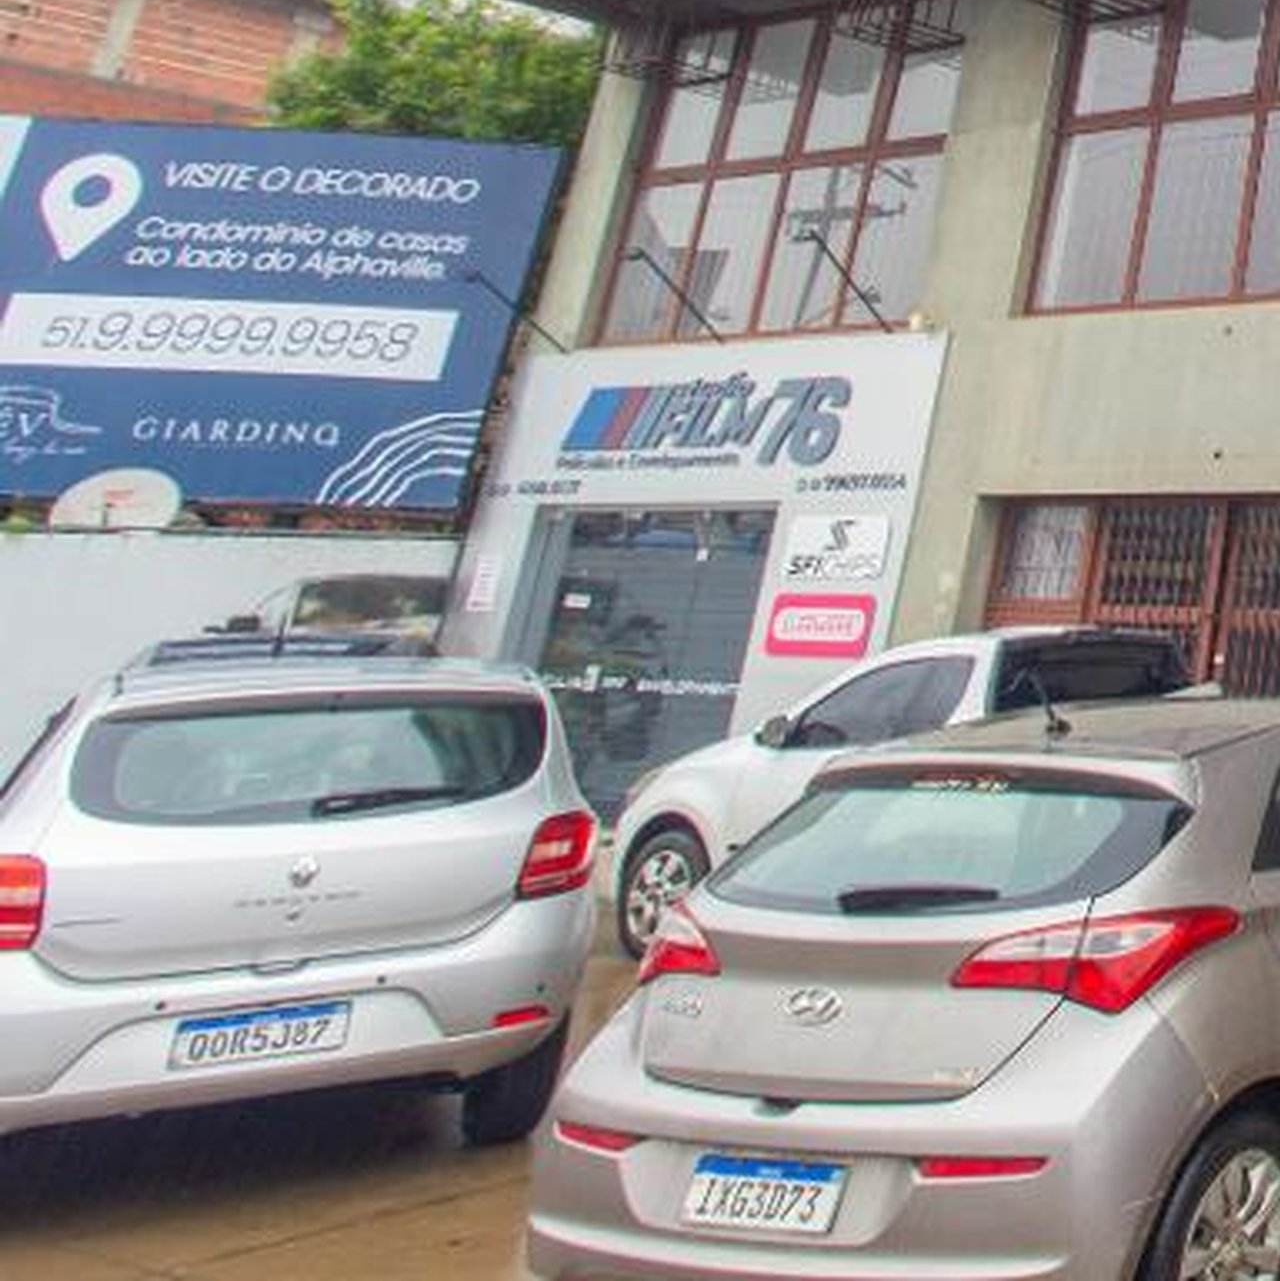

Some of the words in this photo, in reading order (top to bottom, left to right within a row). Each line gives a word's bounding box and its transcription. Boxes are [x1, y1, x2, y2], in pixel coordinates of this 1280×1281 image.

[164, 161, 257, 192] VISITE
[259, 164, 292, 193] O
[293, 168, 482, 205] DECORADO
[125, 246, 172, 268] ao
[174, 245, 250, 271] lado
[252, 247, 298, 272] do
[331, 224, 375, 248] de
[377, 231, 470, 255] casas
[41, 311, 420, 363] 51.9.9999.9958
[752, 375, 852, 467] 76
